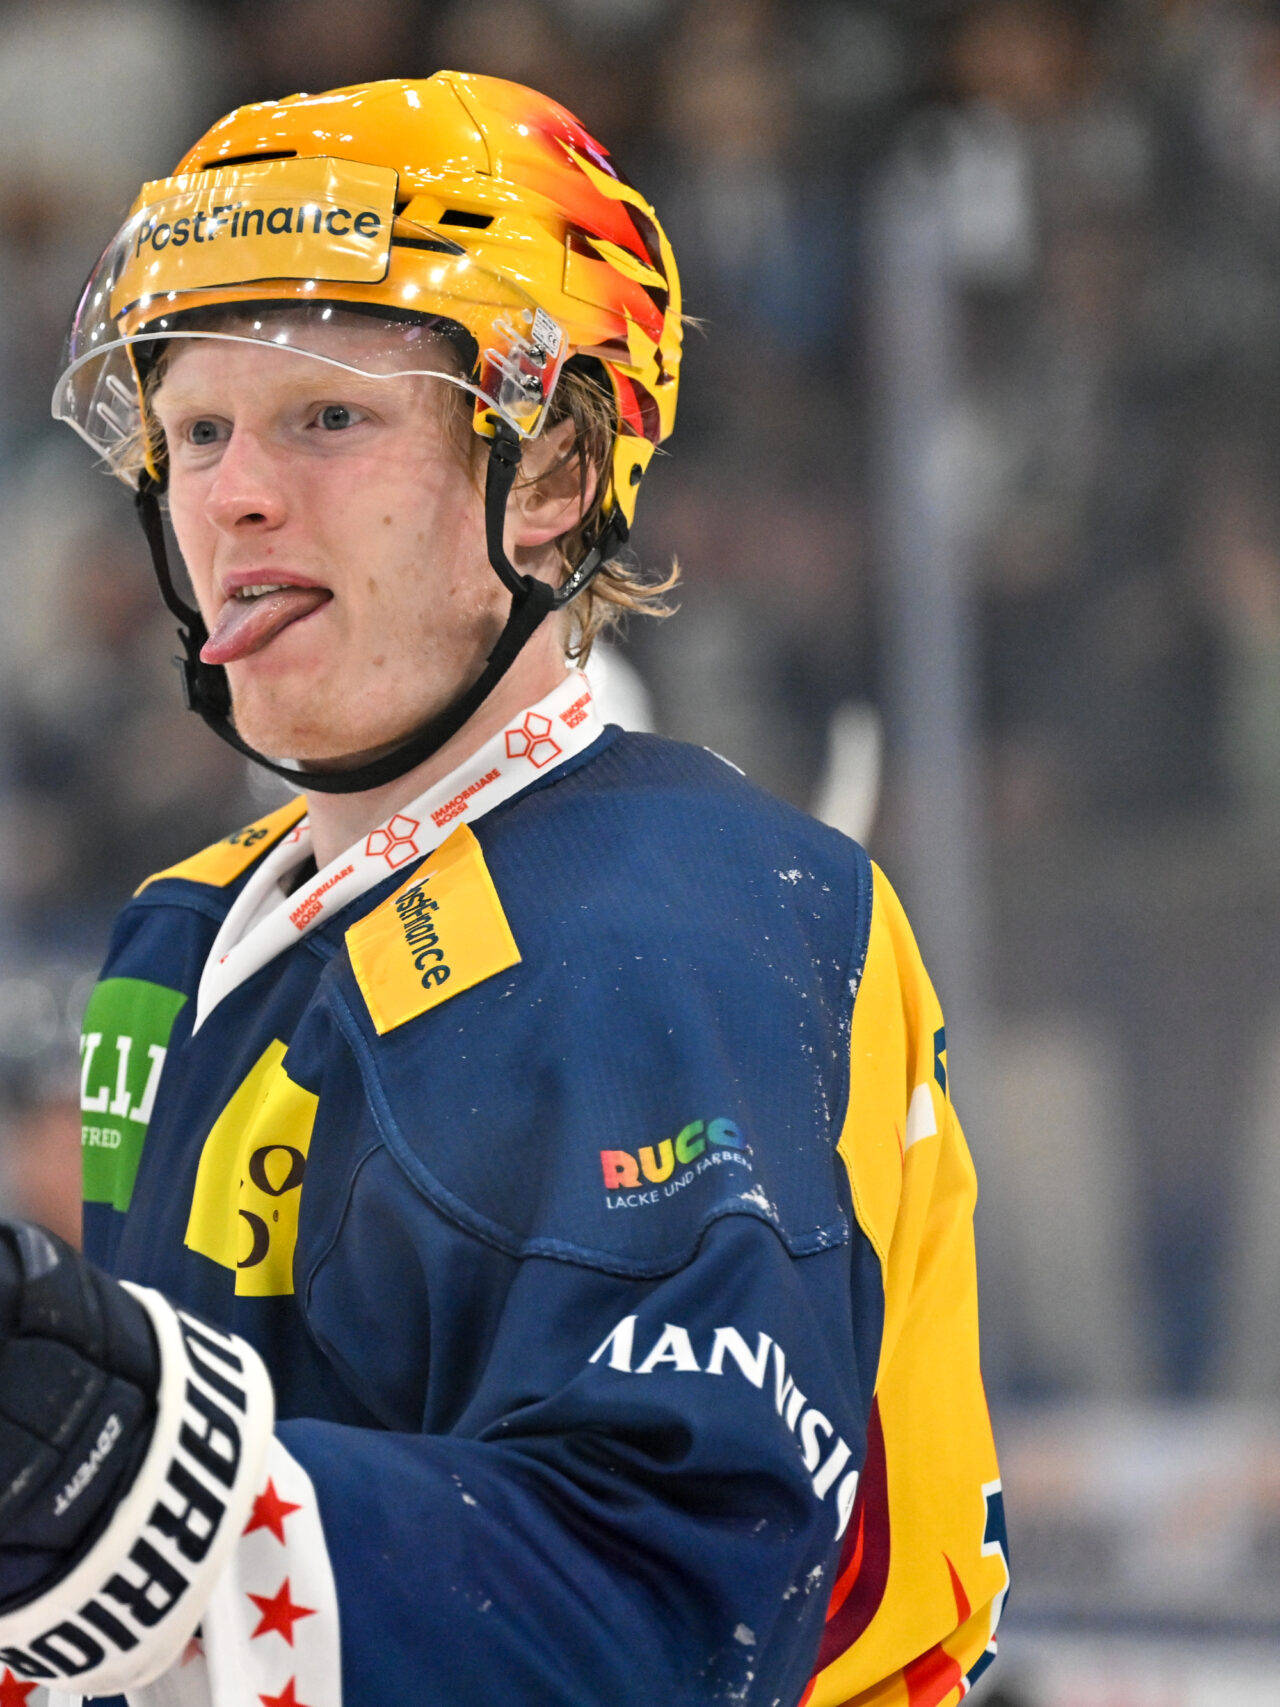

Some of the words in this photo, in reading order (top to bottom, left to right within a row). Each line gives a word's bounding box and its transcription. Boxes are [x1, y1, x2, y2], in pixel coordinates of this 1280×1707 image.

[136, 201, 382, 258] PostFinance
[430, 768, 502, 822] IMMOBILIARE
[435, 803, 469, 828] ROSSI
[288, 864, 355, 923] IMMOBILIARE
[294, 901, 324, 931] ROSSI
[600, 1117, 746, 1189] RUCO
[606, 1190, 660, 1210] LACKE
[664, 1171, 695, 1197] UND
[54, 1414, 121, 1516] COVERT
